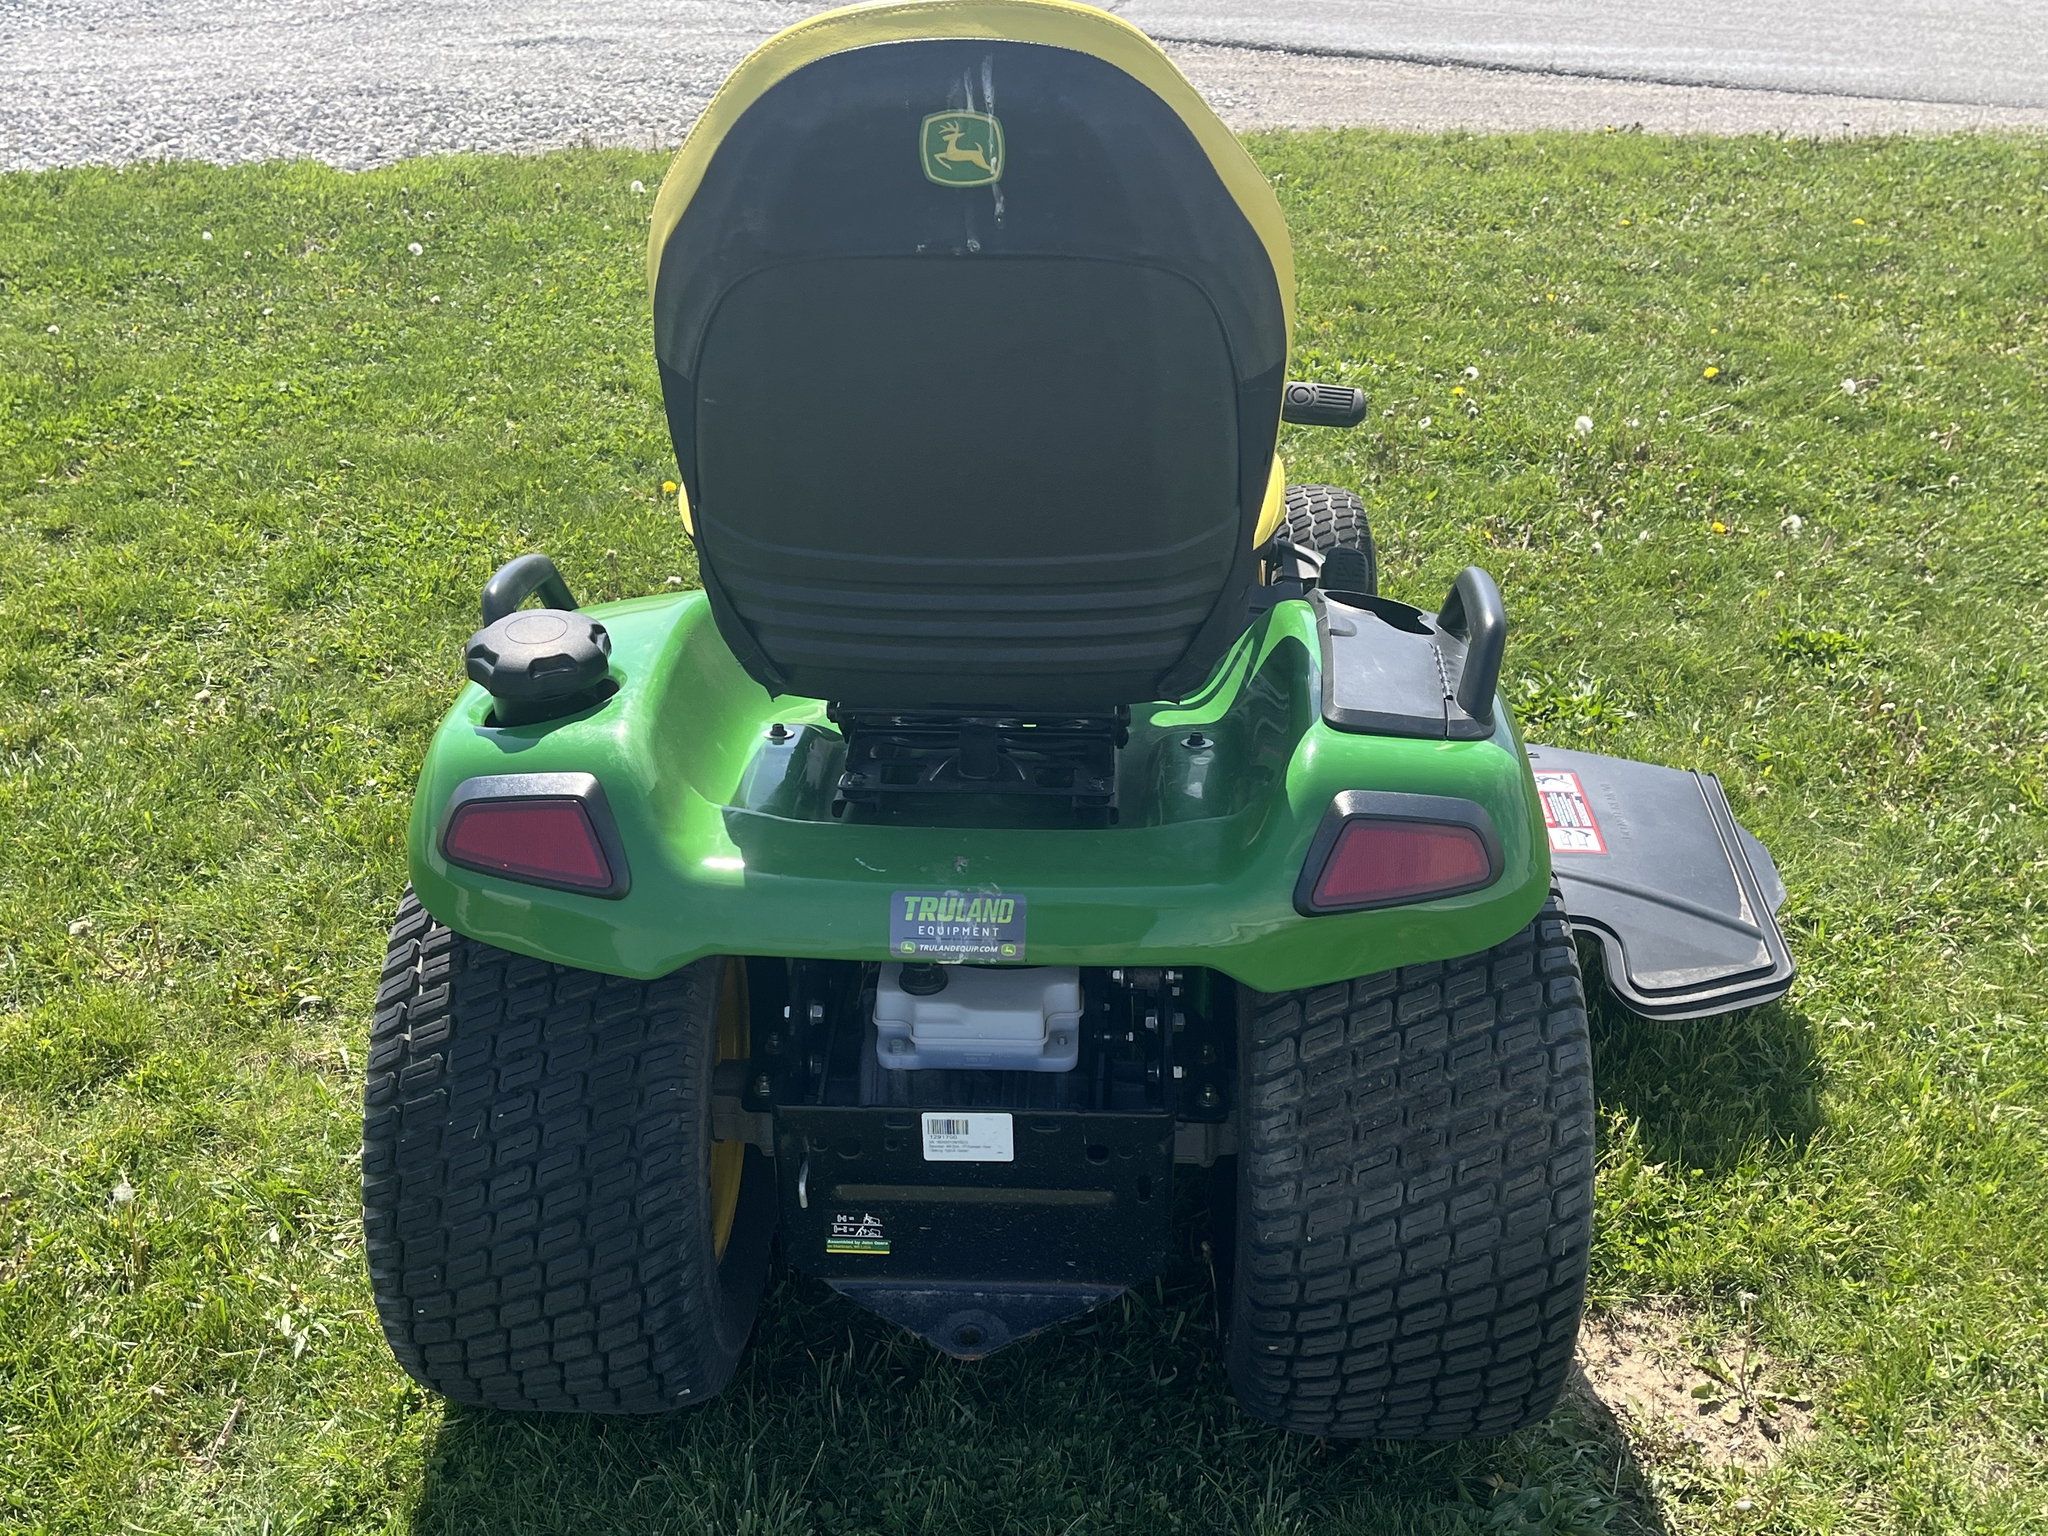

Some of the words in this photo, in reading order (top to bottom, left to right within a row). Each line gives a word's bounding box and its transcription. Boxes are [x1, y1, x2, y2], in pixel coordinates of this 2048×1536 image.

[904, 896, 1015, 924] TRULAND
[918, 925, 1000, 937] EQUIPMENT
[919, 944, 998, 953] TRULANDEQUIP.COM
